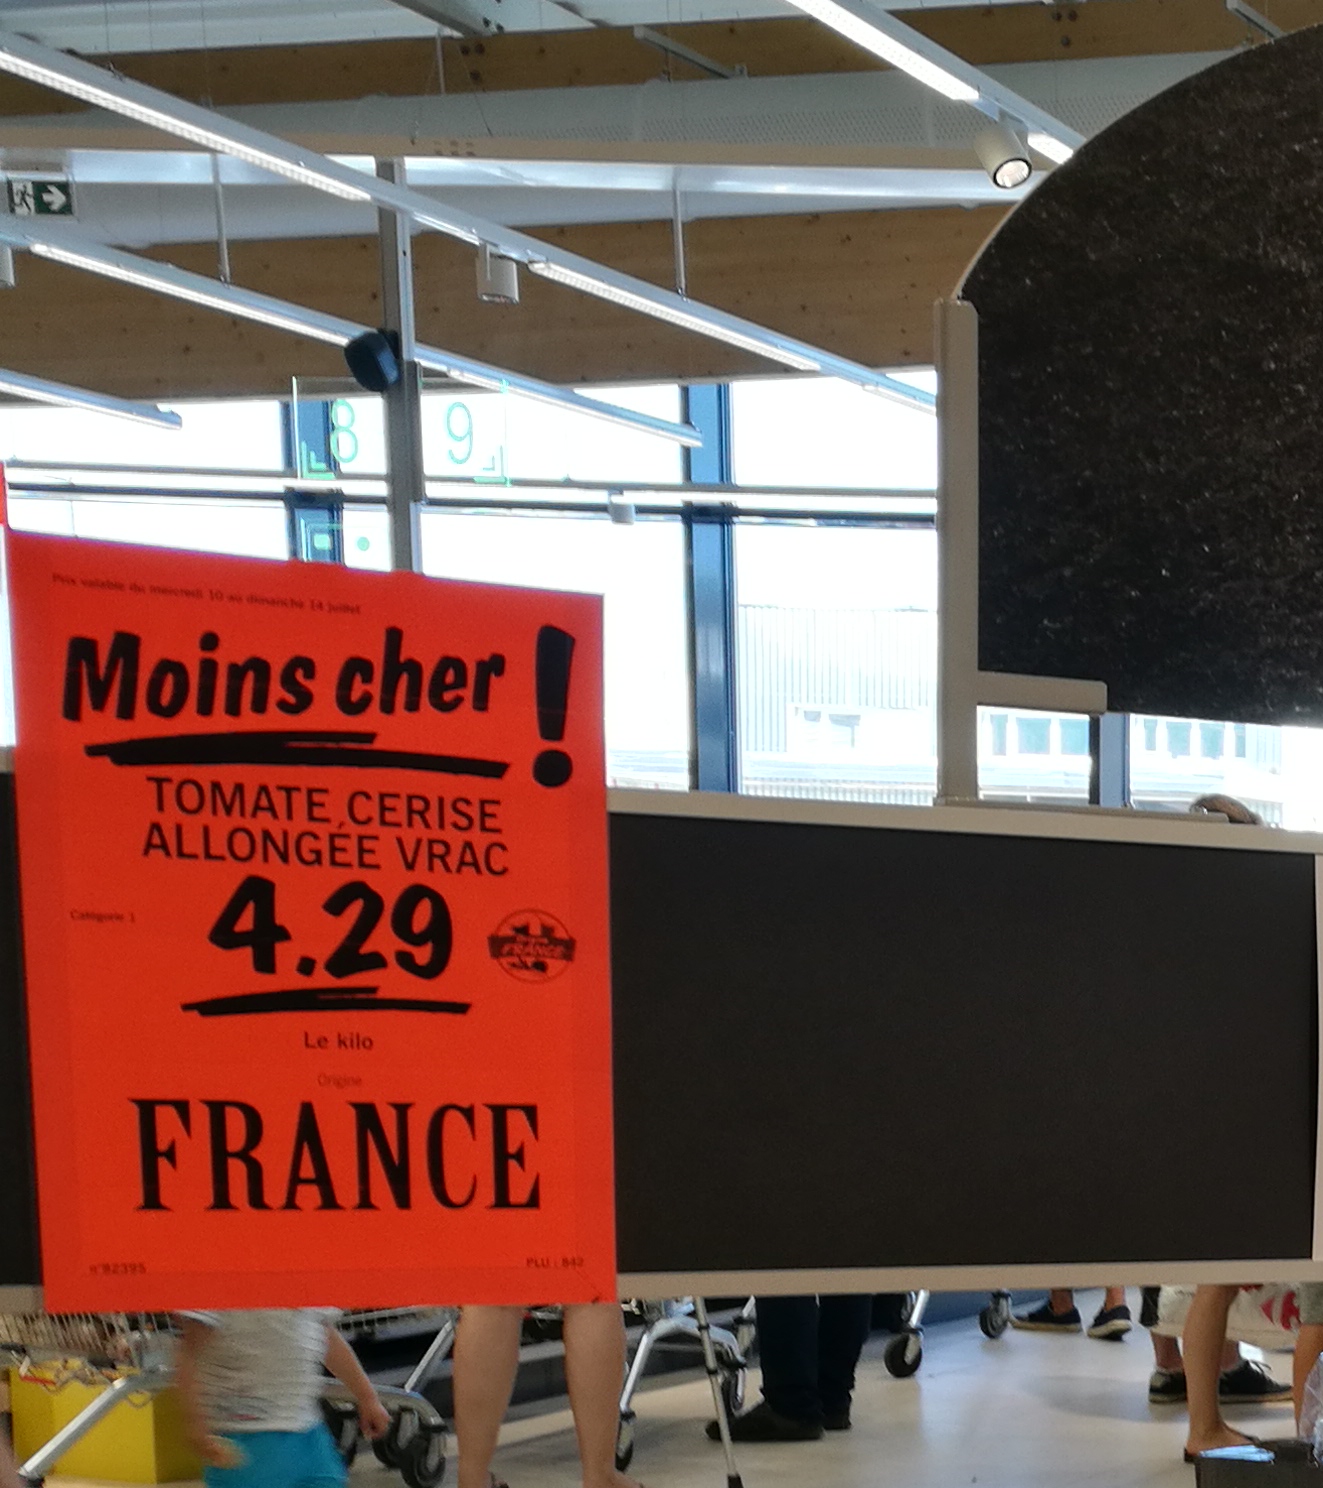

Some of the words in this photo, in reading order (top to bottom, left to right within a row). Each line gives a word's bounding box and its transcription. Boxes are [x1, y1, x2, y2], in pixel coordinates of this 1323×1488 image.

[446, 401, 474, 465] 9
[62, 630, 317, 722] Moins
[334, 626, 506, 716] cher
[147, 777, 332, 825] TOMATE
[346, 790, 503, 834] CERISE
[141, 818, 382, 872] ALLONGÉE
[397, 834, 510, 877] VRAC
[207, 875, 453, 982] 4.29
[304, 1032, 330, 1050] Le
[337, 1030, 375, 1052] kilo
[128, 1096, 542, 1212] FRANCE
